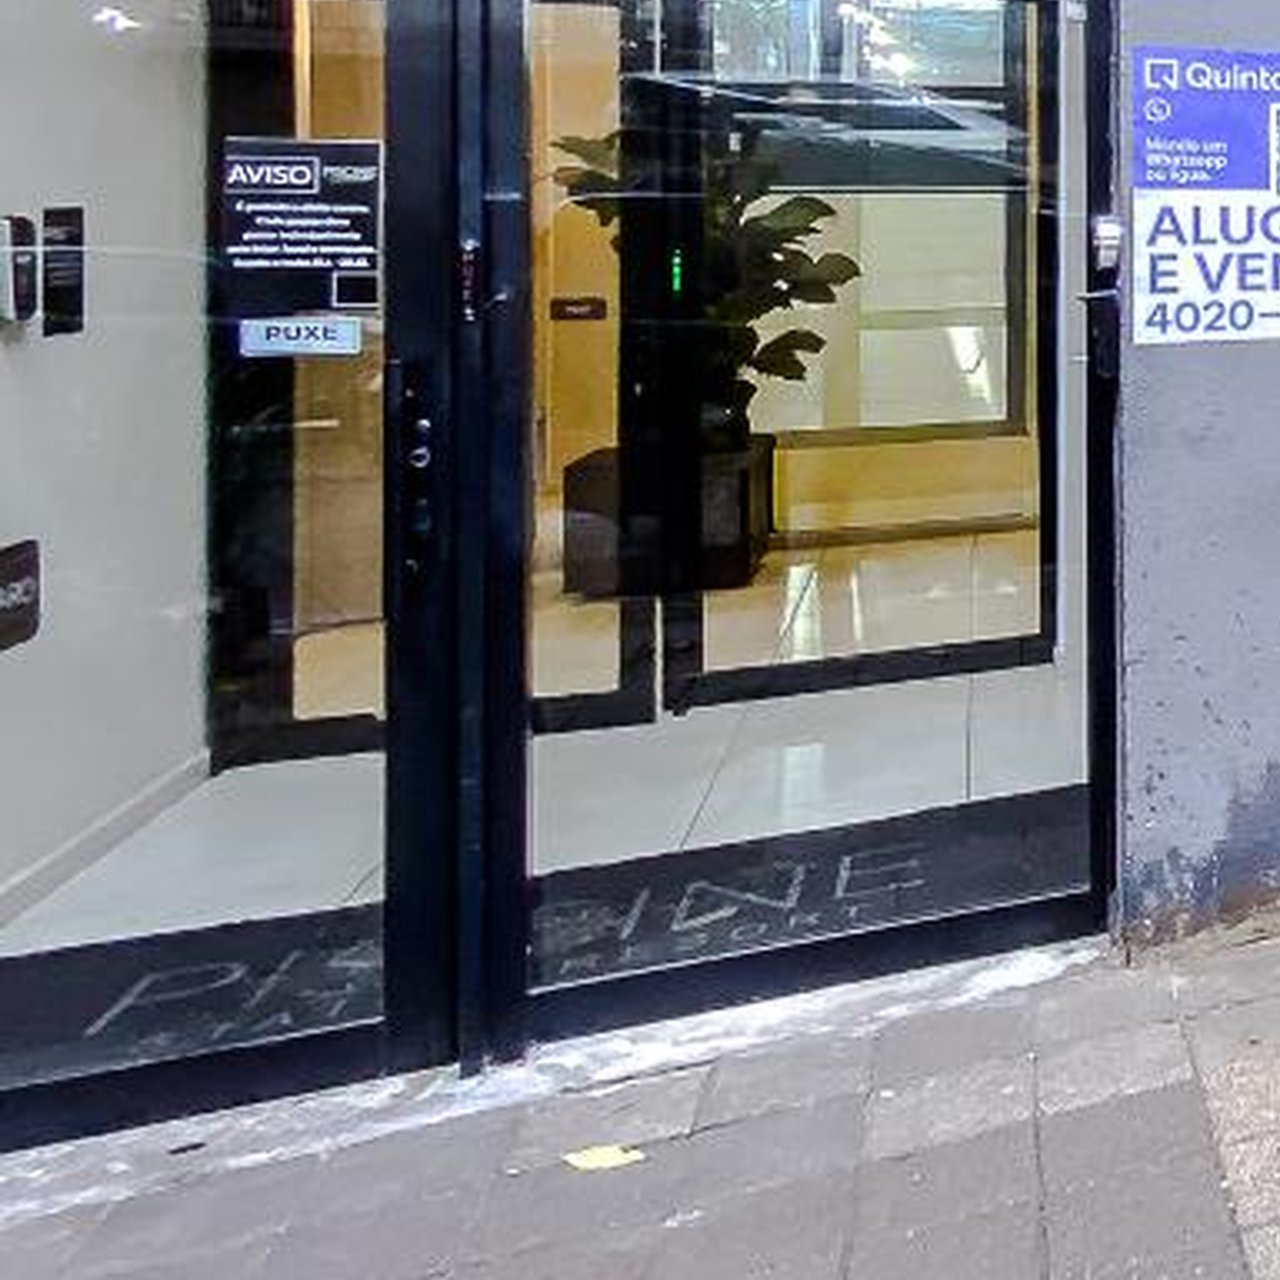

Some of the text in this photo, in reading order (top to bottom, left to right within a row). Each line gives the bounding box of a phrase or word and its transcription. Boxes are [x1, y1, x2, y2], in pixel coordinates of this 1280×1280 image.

[227, 164, 312, 185] AVISO
[1149, 253, 1179, 294] E
[265, 325, 338, 341] PUXE
